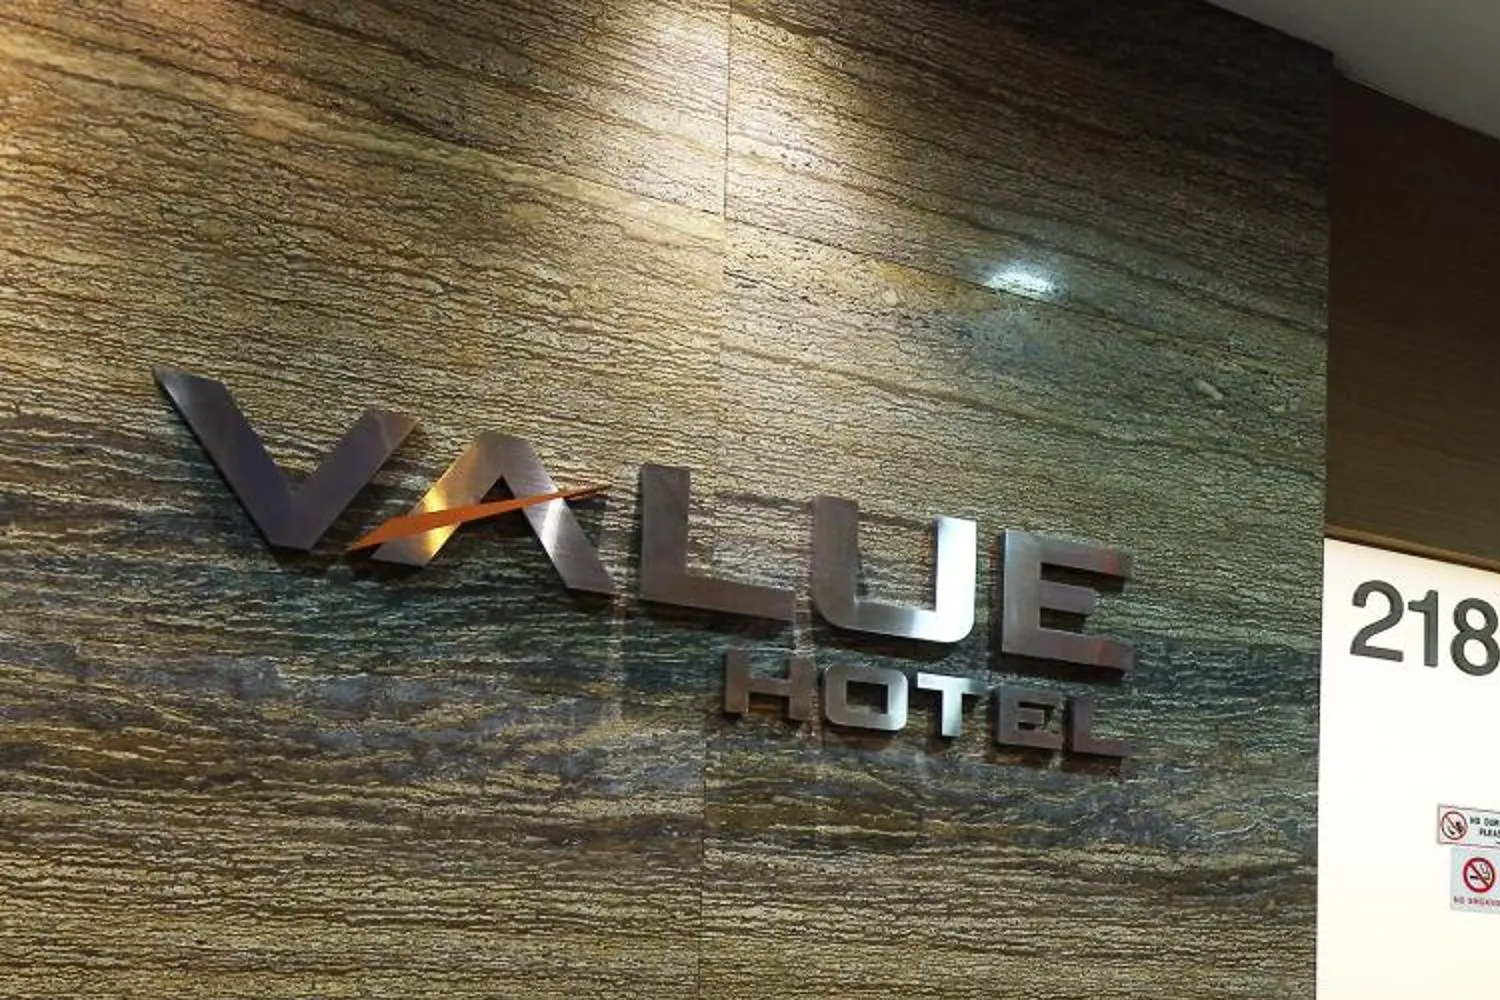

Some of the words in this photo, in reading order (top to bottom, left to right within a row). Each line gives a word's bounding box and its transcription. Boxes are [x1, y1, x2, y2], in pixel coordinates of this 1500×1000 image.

[153, 366, 1136, 670] VALUE
[1350, 579, 1500, 677] 218
[723, 648, 1131, 757] HOTEL
[1469, 816, 1480, 825] NO
[1453, 895, 1464, 904] NO
